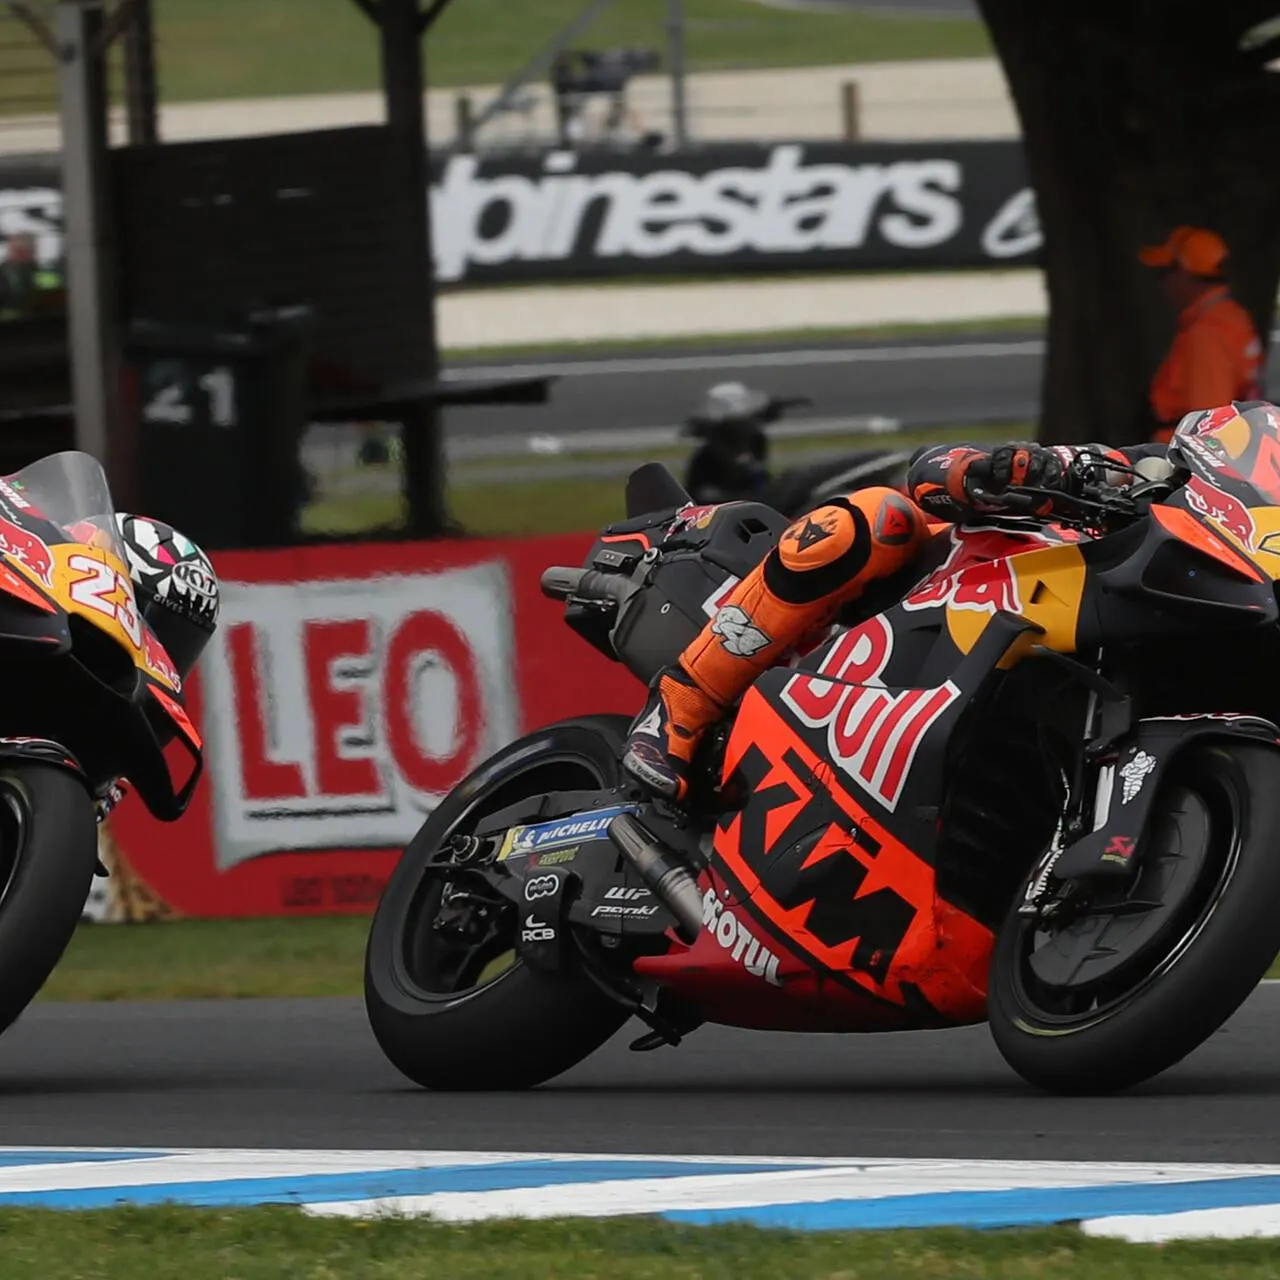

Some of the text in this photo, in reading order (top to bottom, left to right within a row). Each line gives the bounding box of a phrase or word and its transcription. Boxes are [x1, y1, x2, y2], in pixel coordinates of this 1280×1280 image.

[223, 609, 484, 800] LEO
[779, 612, 962, 814] Bull
[521, 928, 556, 942] RCB
[603, 886, 652, 900] WP
[702, 887, 784, 988] MOTUL
[717, 740, 920, 989] KTM
